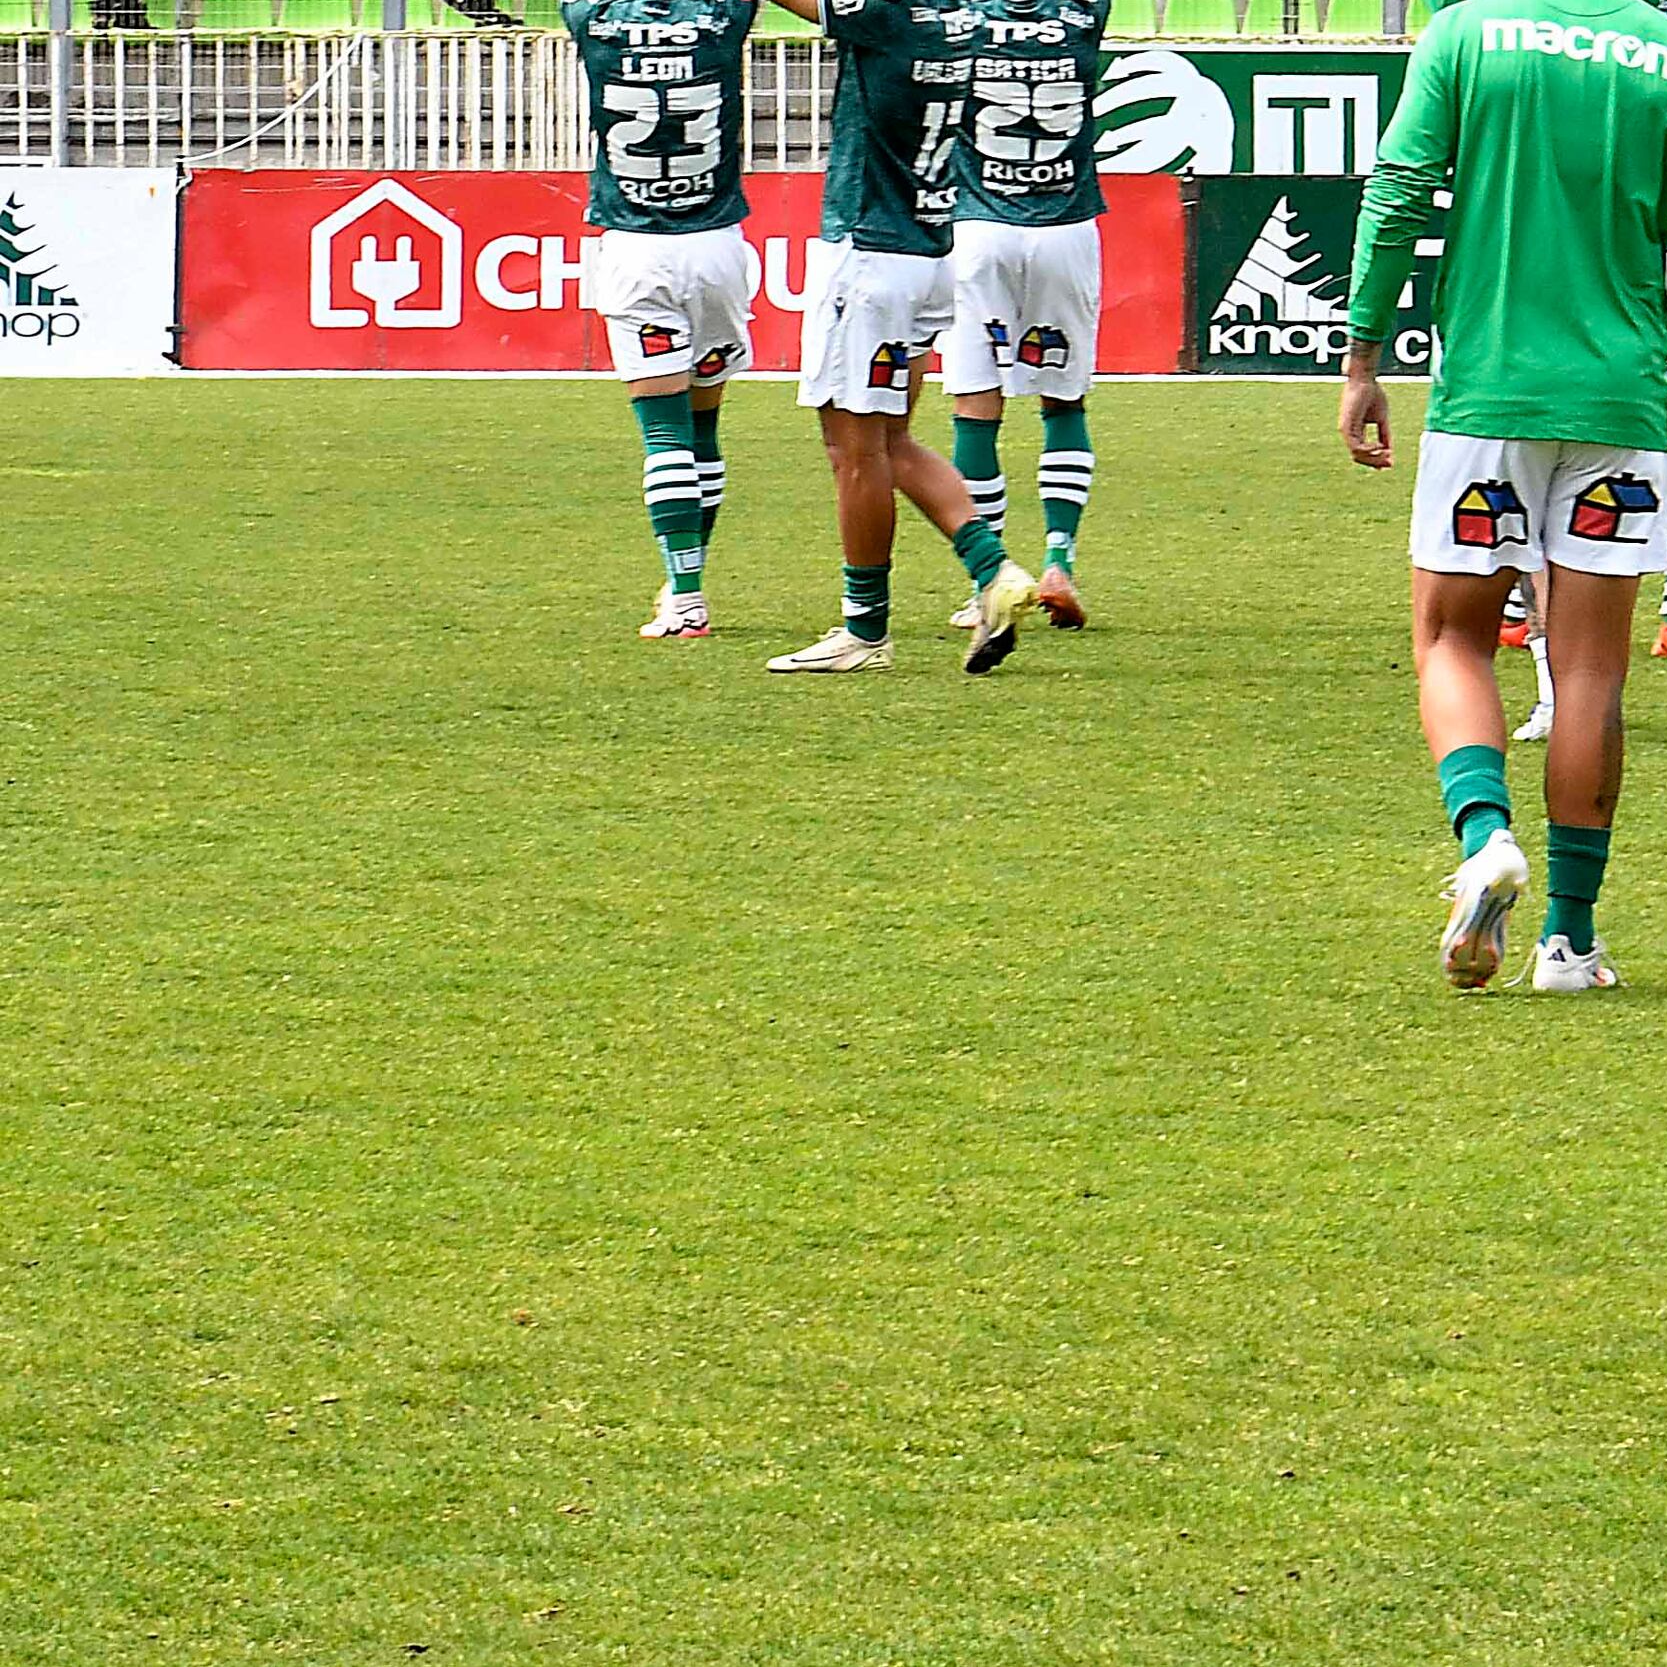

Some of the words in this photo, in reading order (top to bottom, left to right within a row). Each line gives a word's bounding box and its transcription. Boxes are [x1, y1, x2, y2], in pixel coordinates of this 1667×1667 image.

[621, 20, 700, 46] TPS
[984, 20, 1067, 44] TPS
[622, 55, 694, 81] LEON
[603, 82, 723, 180] 23
[618, 172, 715, 198] RICOH
[982, 160, 1075, 184] RICOH
[1209, 324, 1353, 364] knop
